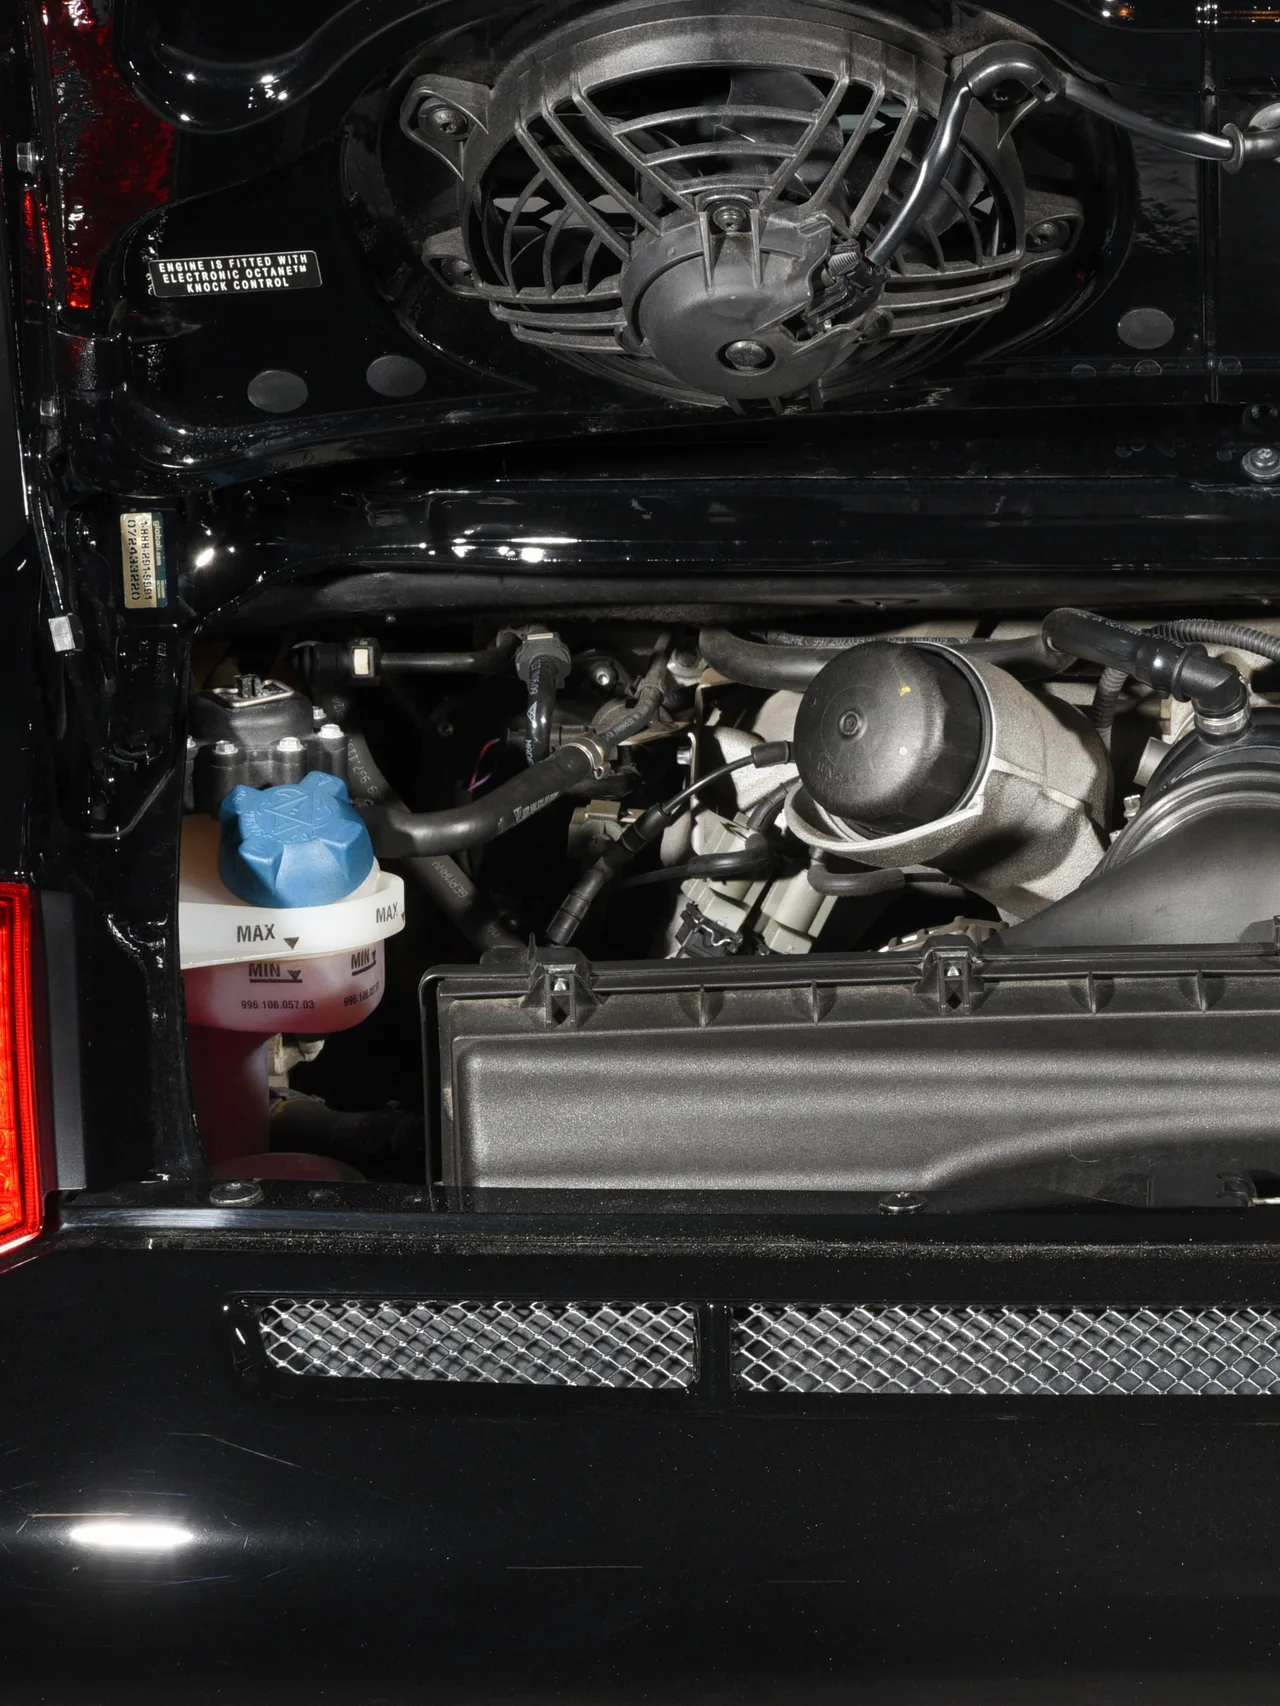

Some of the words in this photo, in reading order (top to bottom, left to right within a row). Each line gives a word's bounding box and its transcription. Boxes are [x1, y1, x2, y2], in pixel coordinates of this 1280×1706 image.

[159, 260, 204, 272] ENGINE
[211, 259, 223, 269] IS
[229, 256, 272, 269] FITTED
[278, 254, 307, 265] WITH
[162, 269, 239, 283] ELECTRONIC
[187, 281, 228, 293] KNOCK
[233, 277, 289, 290] CONTROL
[128, 519, 140, 600] 072433220
[431, 860, 469, 900] GERMANY
[376, 902, 398, 924] MAX
[237, 923, 276, 943] MAX
[351, 948, 371, 969] MIN
[248, 963, 281, 978] MIN
[241, 1000, 315, 1010] 996.106.057.03
